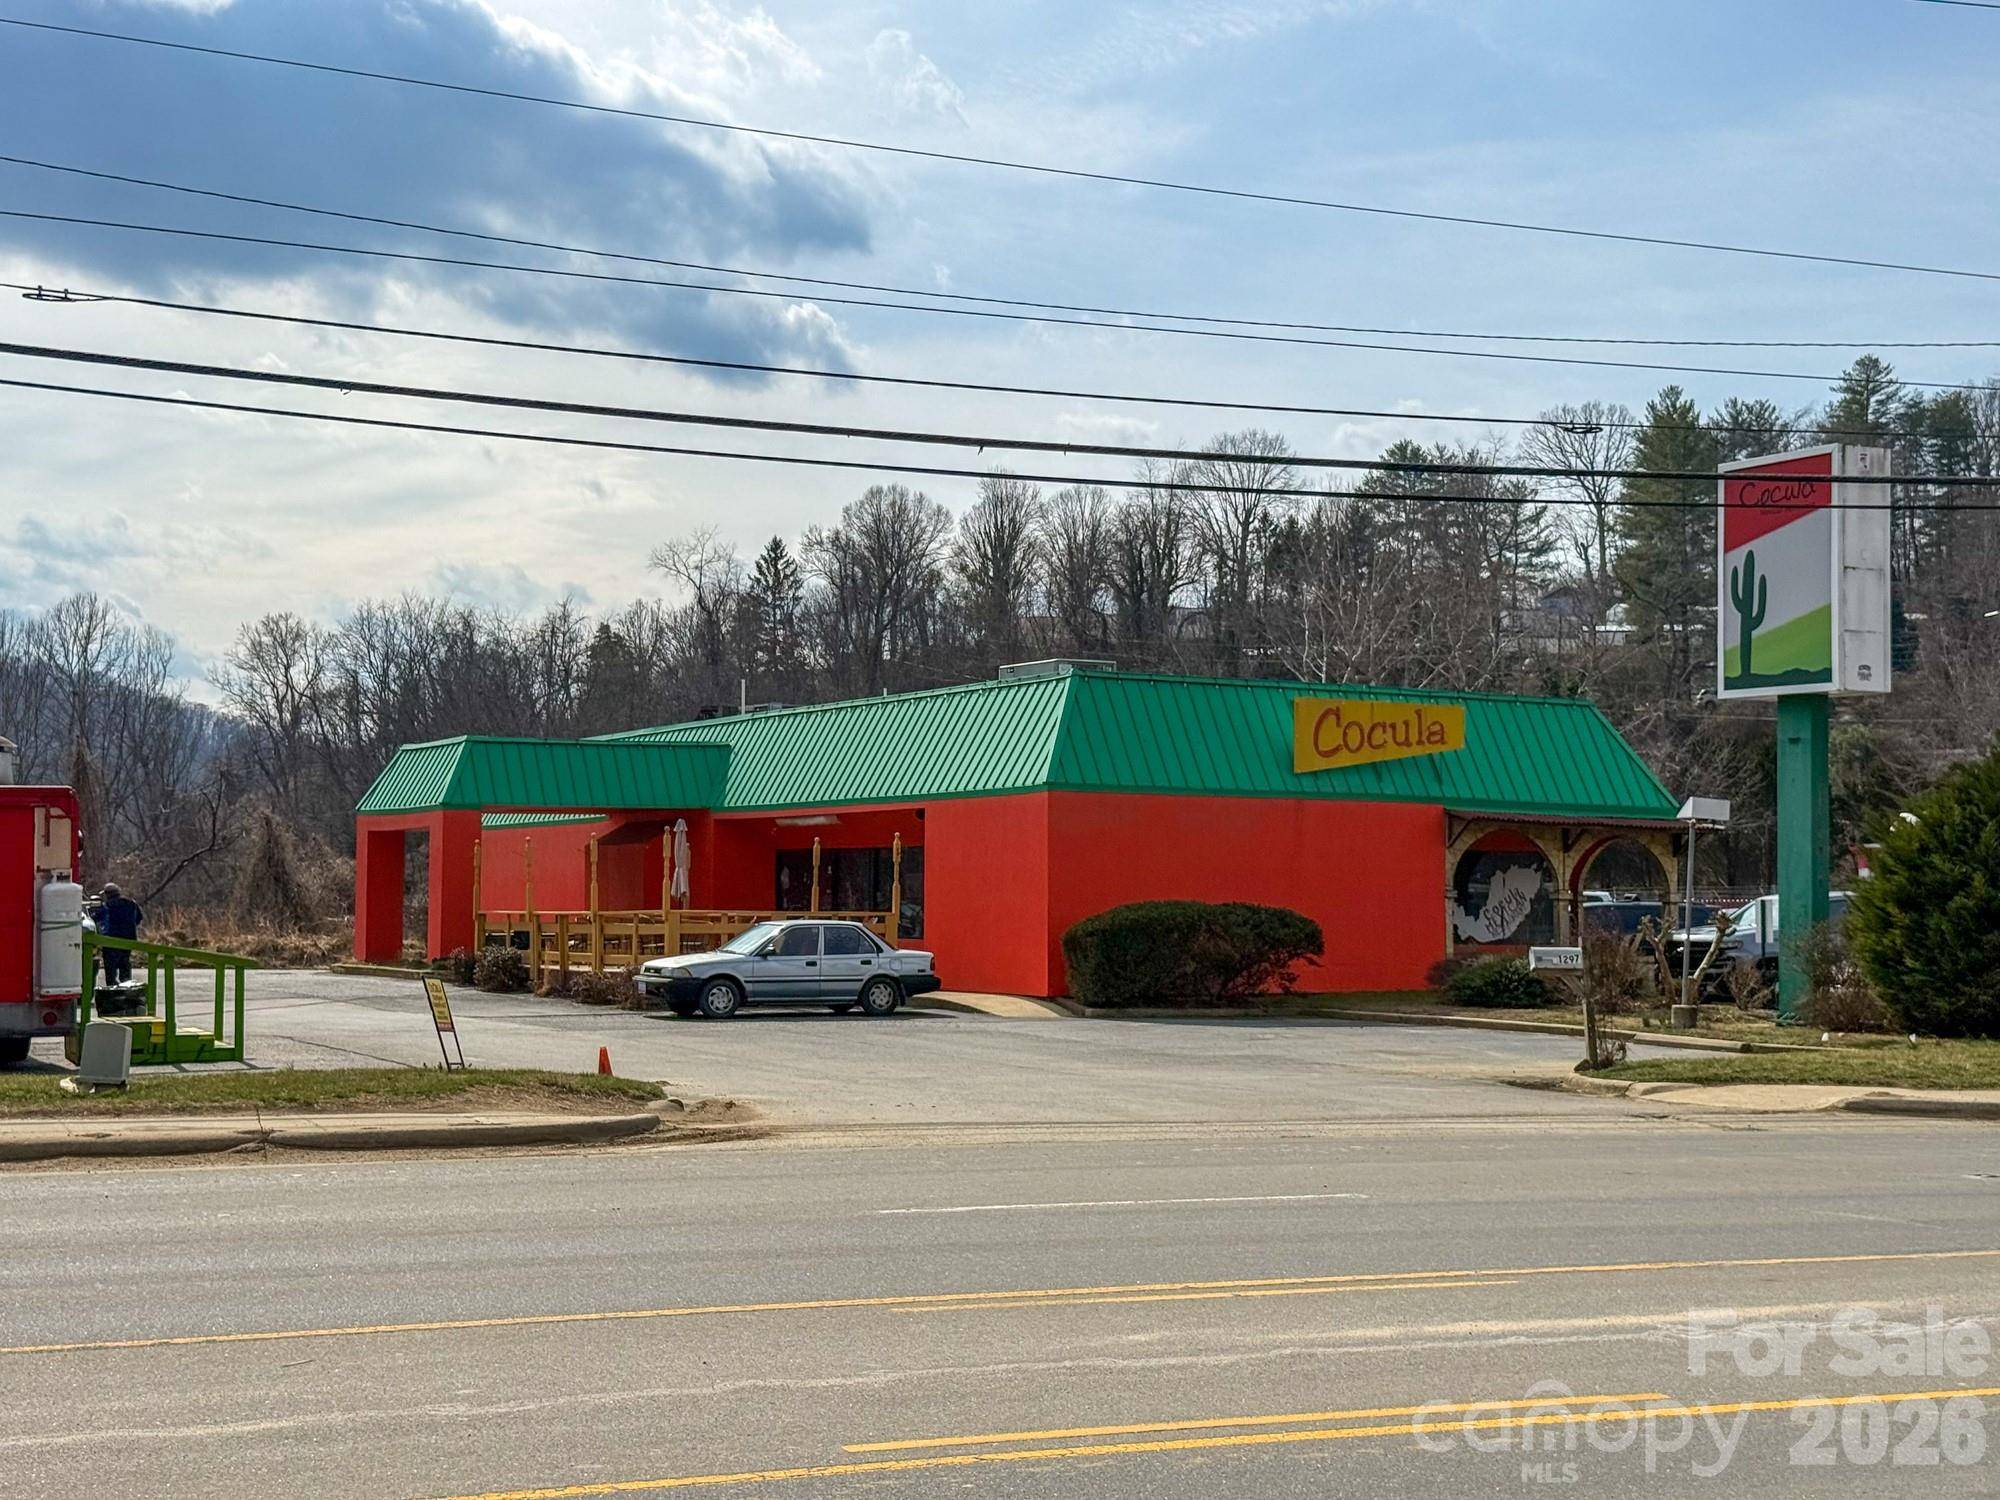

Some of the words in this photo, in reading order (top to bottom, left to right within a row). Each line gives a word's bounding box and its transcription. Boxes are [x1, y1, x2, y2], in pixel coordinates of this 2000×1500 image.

[1739, 480, 1816, 507] Cocula
[1313, 706, 1448, 758] Cocula
[1558, 954, 1579, 964] 1297
